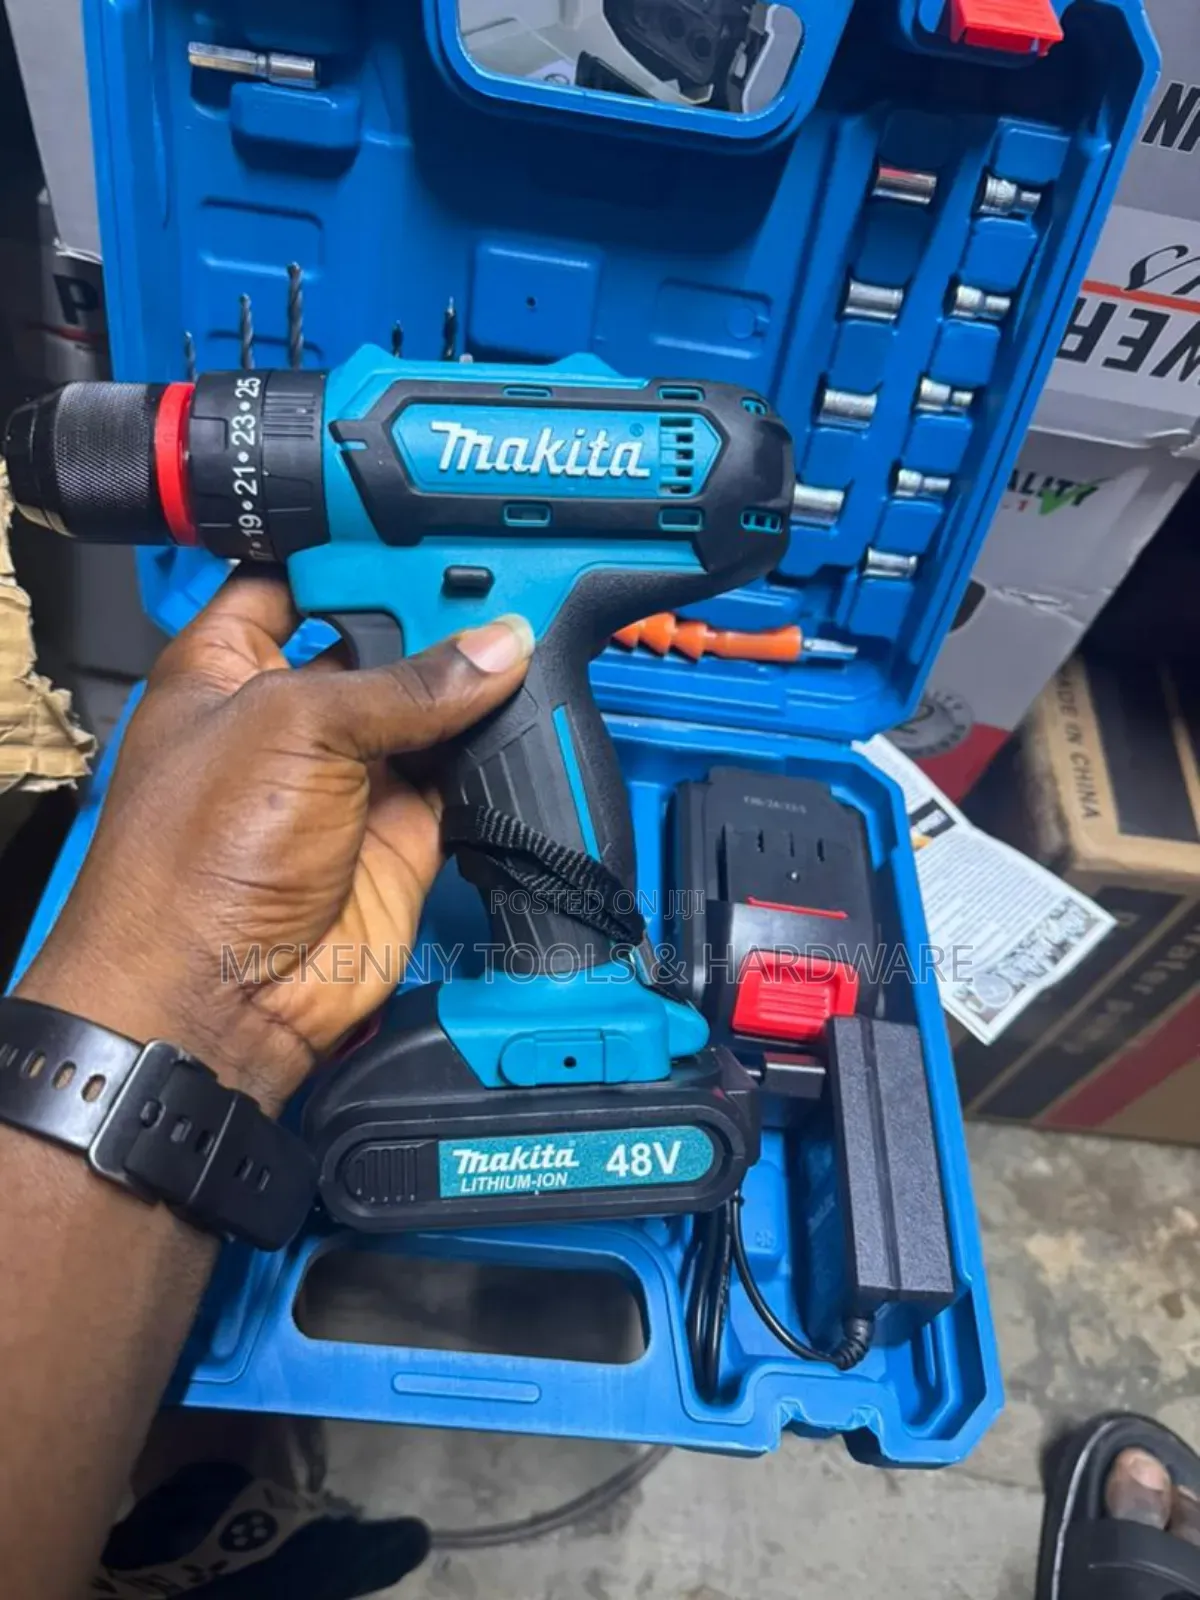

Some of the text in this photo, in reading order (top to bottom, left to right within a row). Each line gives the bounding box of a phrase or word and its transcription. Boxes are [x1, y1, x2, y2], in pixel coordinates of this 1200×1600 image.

[234, 377, 261, 398] 25
[230, 414, 256, 446] 23
[232, 466, 257, 496] 21
[1069, 751, 1101, 819] CHINA
[605, 1141, 682, 1178] 48V
[460, 1172, 569, 1194] LITHIUM-ION
